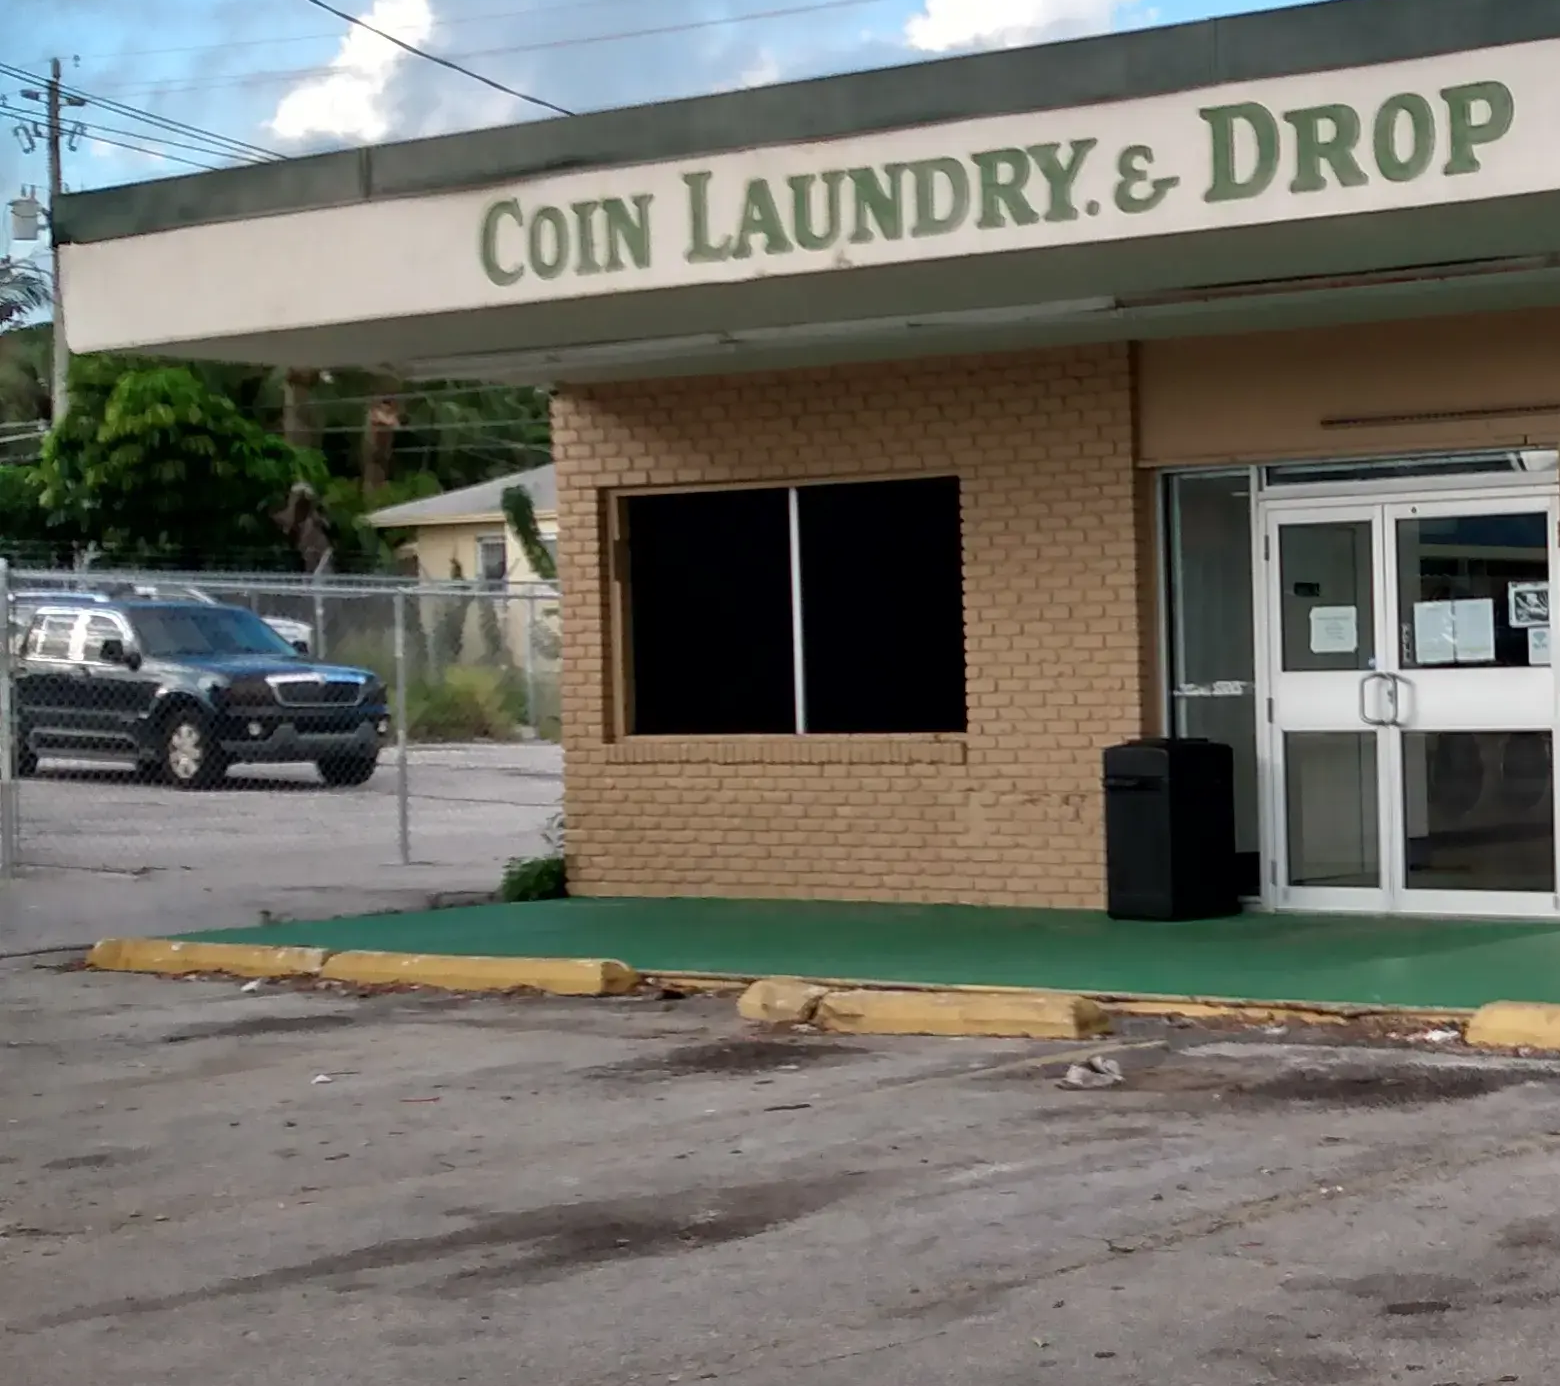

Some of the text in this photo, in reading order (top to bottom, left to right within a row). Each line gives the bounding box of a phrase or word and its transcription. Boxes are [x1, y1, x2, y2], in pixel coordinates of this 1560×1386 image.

[480, 193, 655, 287] COIN
[1113, 144, 1181, 214] &
[1198, 79, 1515, 203] DROP
